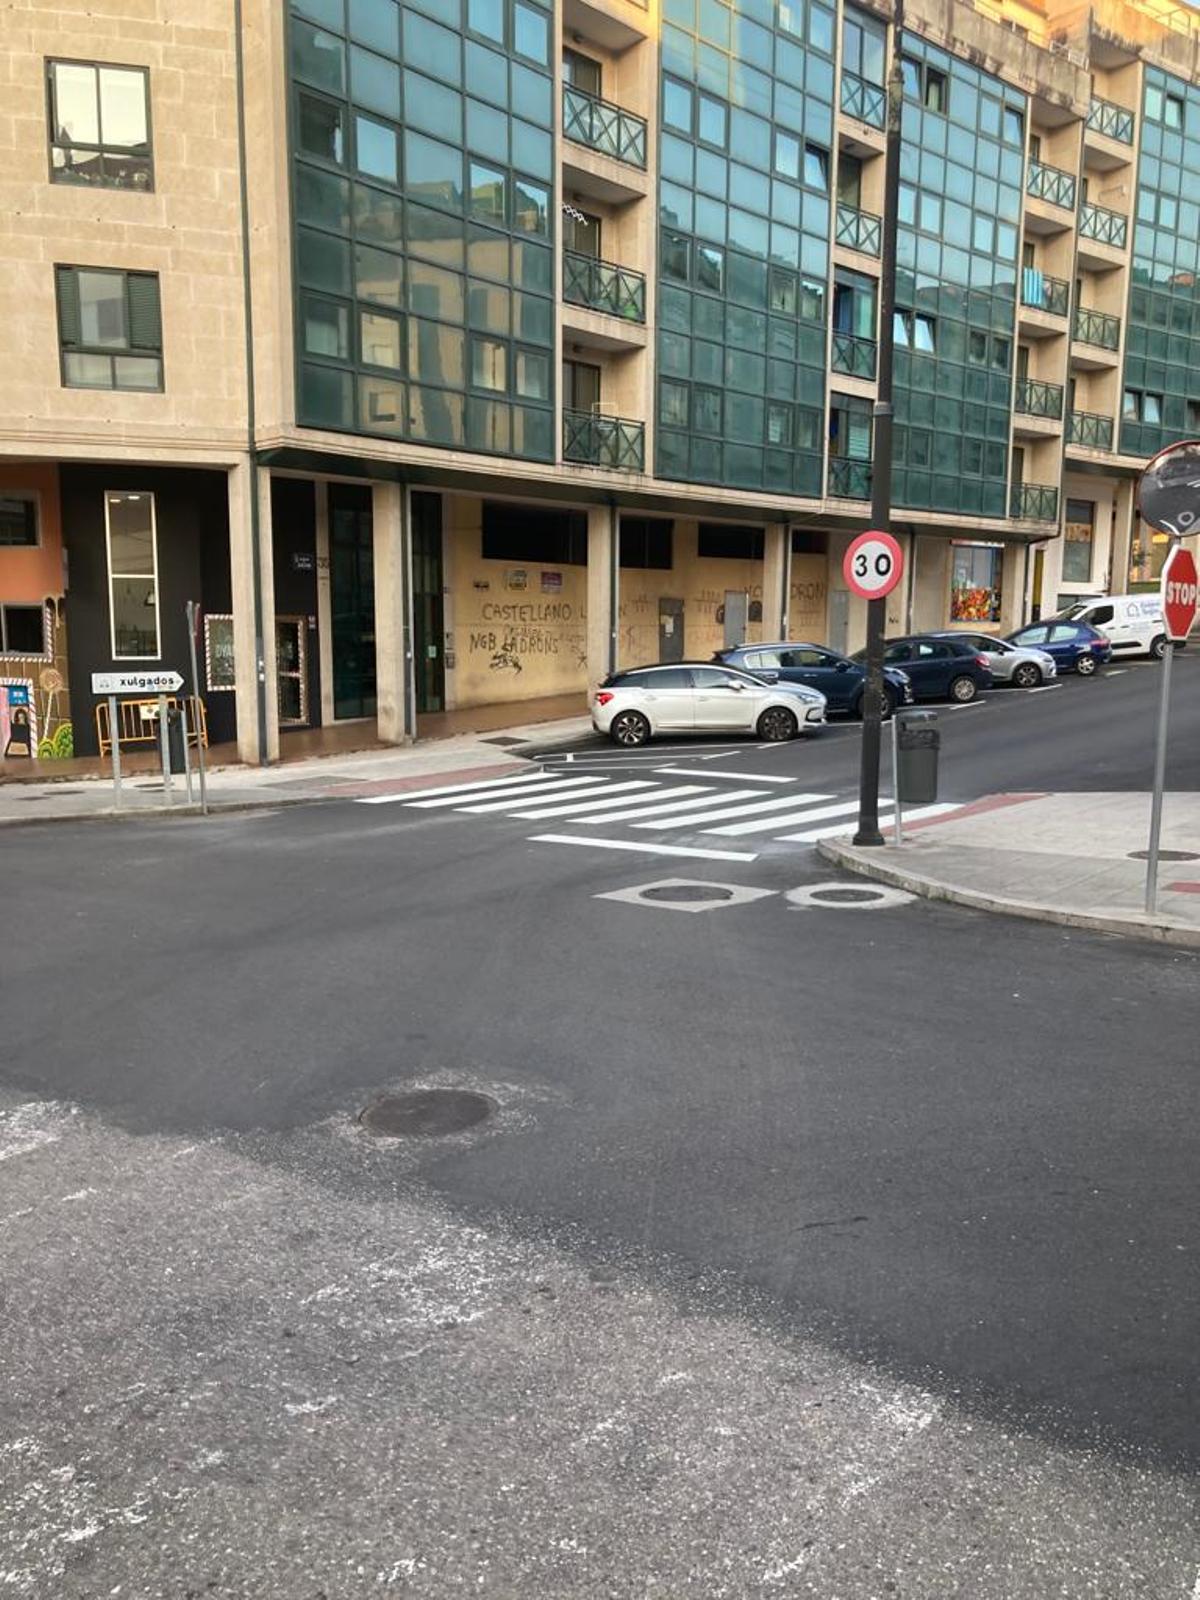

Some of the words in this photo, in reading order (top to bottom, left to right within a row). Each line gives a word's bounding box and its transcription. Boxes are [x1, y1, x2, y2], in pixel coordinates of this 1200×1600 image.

[855, 553, 892, 577] 30
[1166, 580, 1197, 606] STOP
[482, 602, 572, 621] CASTELLANO
[119, 676, 175, 688] xulgados
